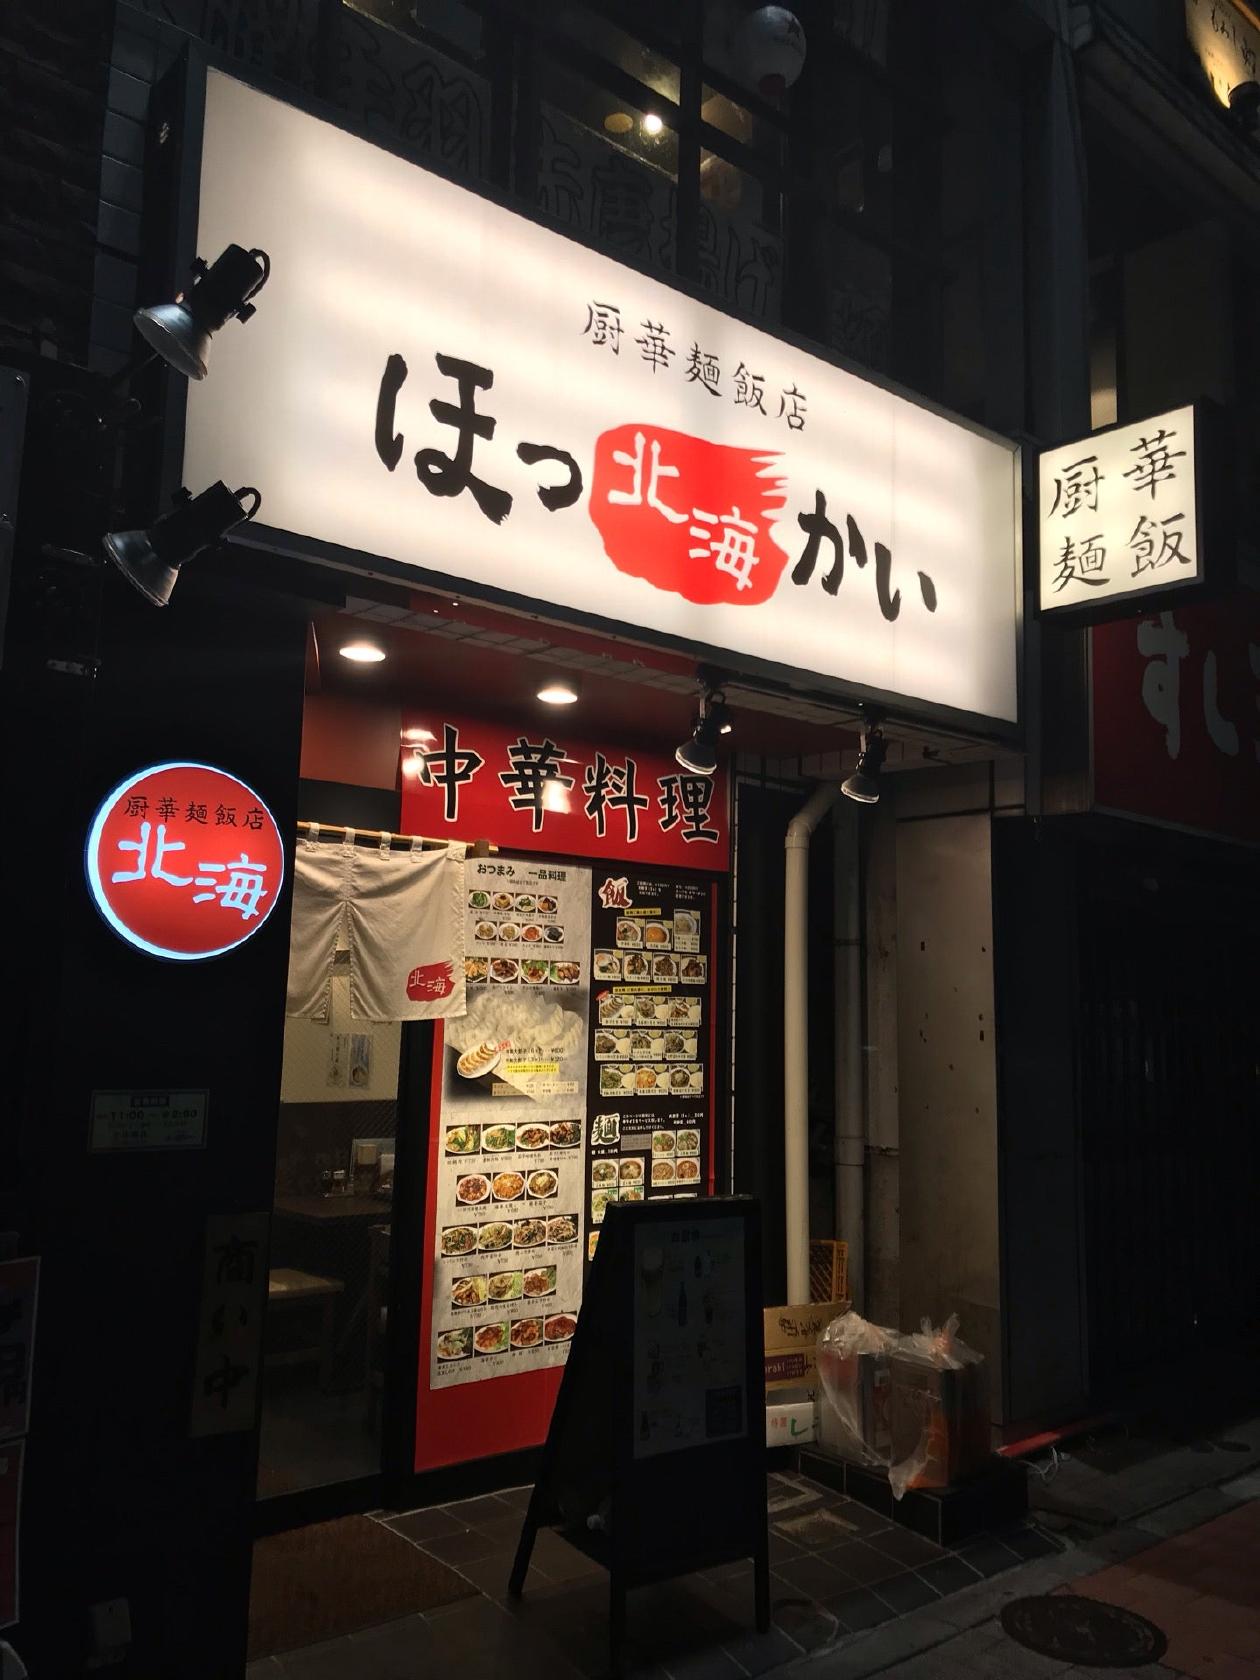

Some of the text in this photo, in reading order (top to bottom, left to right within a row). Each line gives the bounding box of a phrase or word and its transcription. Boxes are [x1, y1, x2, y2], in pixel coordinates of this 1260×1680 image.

[581, 301, 808, 431] 厨華麺飯店
[374, 351, 938, 622] ほっ 北海 かい
[414, 722, 720, 844] 中華料理
[123, 796, 265, 830] 厨華麺飯店
[111, 822, 268, 920] 北海
[477, 864, 515, 877] おつまみ
[528, 869, 566, 882] 一品料理
[598, 877, 633, 908] 飯
[409, 970, 446, 995] 北海
[591, 1113, 620, 1146] 麺
